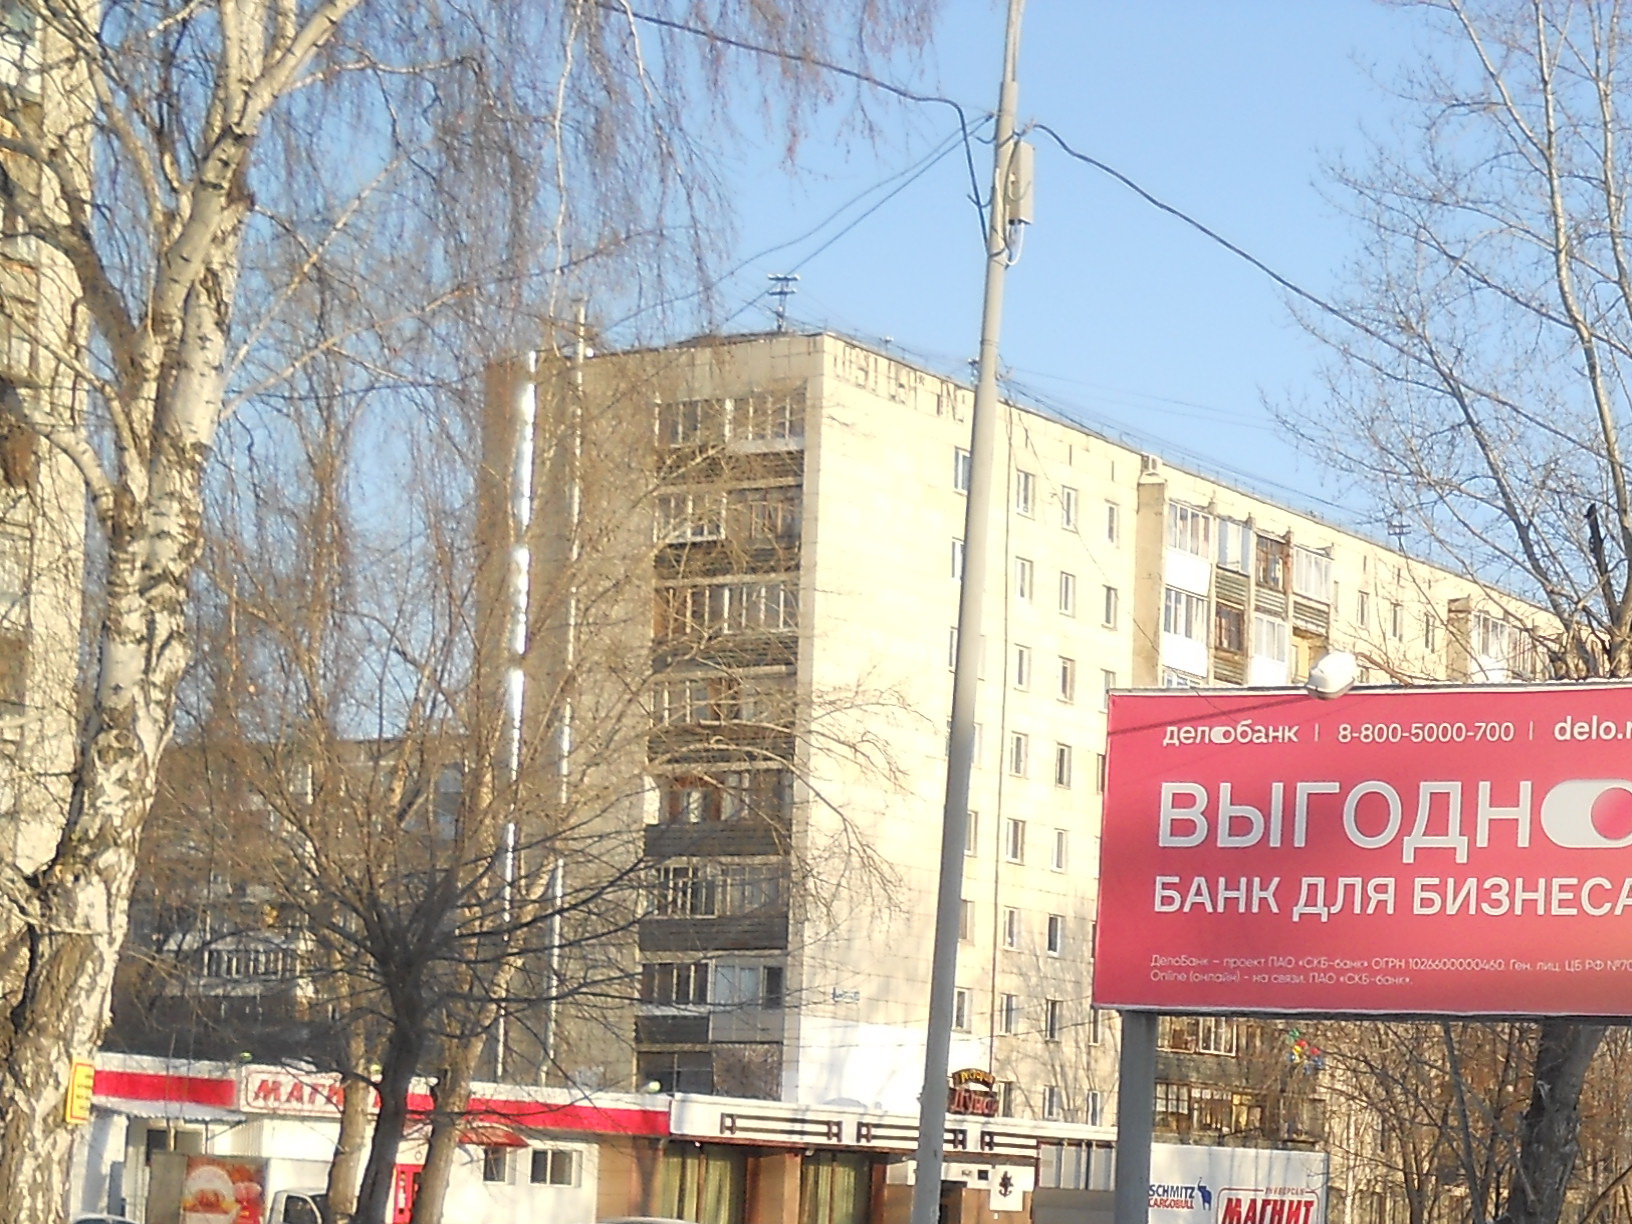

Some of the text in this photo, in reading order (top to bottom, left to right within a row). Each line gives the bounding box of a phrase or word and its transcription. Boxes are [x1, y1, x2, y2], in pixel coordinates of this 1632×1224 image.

[1338, 723, 1514, 743] 8-800-5000-700
[1154, 876, 1280, 913] БАНК
[1292, 877, 1395, 922] ДЛЯ
[1268, 956, 1295, 968] ПАО
[1371, 958, 1405, 970] ОГРН
[1565, 959, 1582, 972] ЦБ
[1585, 959, 1604, 971] РФ
[1150, 970, 1187, 982] Online
[1252, 974, 1269, 983] на
[1309, 972, 1336, 984] ПАО
[1149, 1184, 1195, 1199] SCHMITZ
[1148, 1197, 1194, 1210] CARGOBULL
